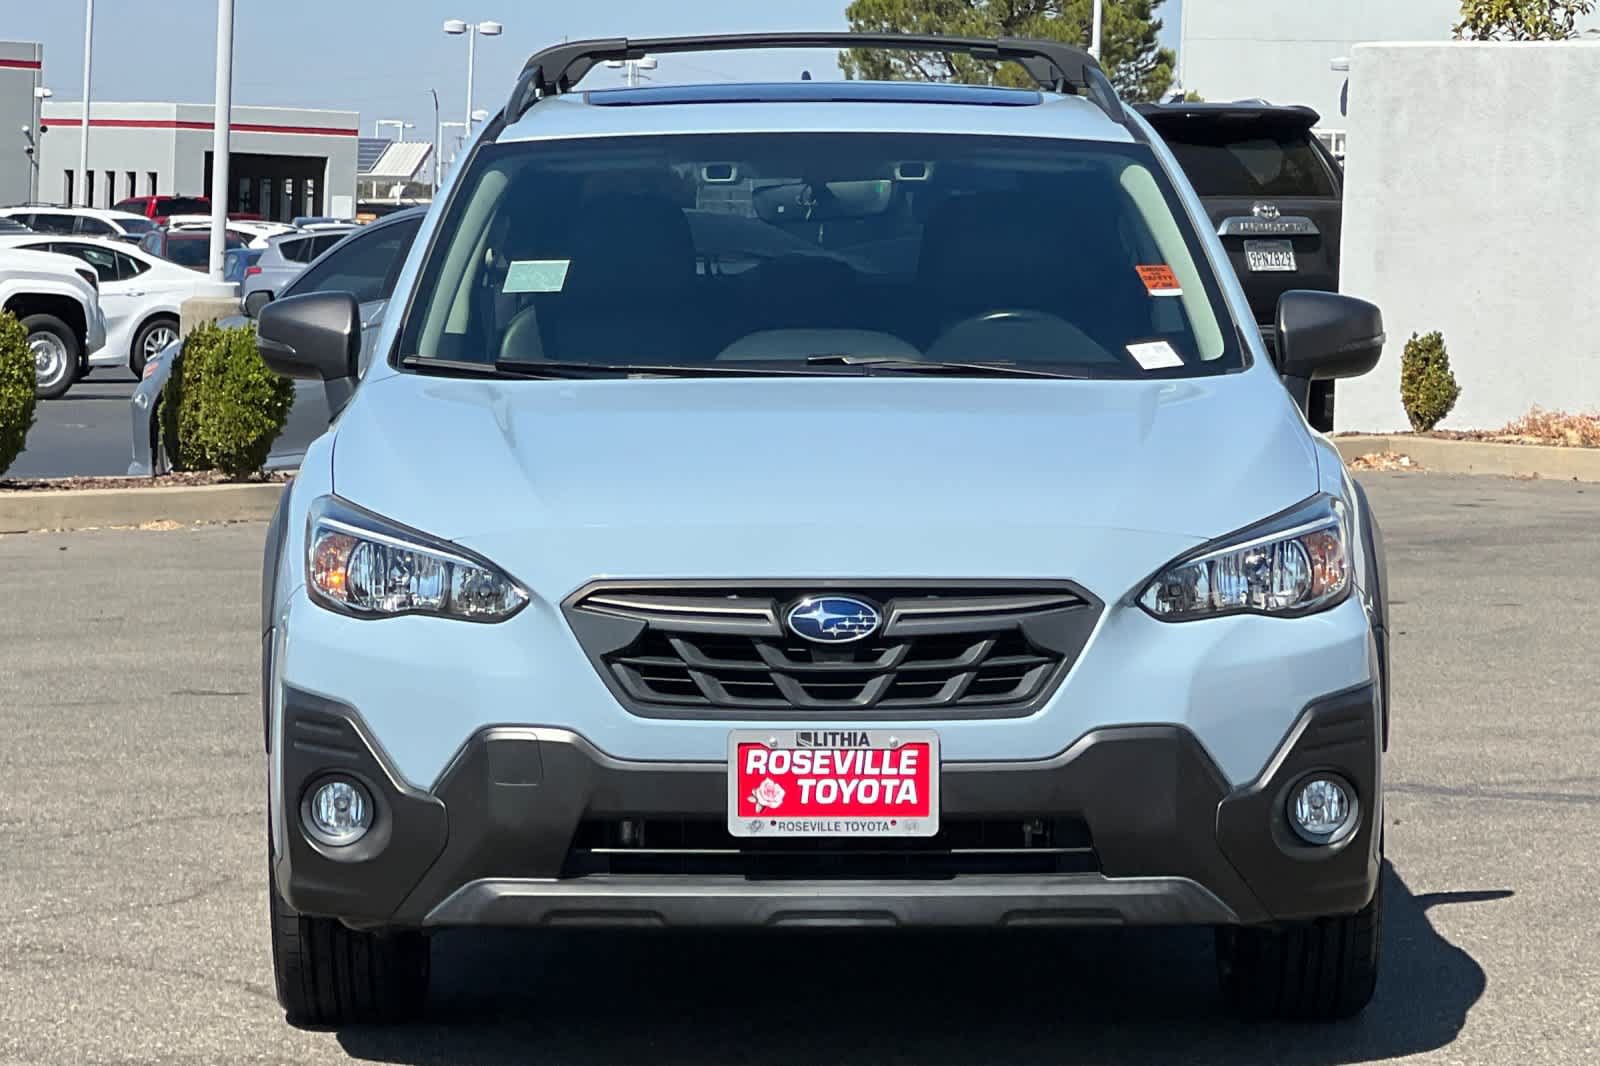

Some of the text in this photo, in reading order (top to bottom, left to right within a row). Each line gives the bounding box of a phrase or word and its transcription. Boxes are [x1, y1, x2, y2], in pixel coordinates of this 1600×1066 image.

[813, 732, 870, 747] LITHIA
[746, 749, 919, 775] ROSEVILLE
[797, 778, 918, 805] TOYOTA
[778, 821, 889, 832] ROSEVILLE TOYOTA
